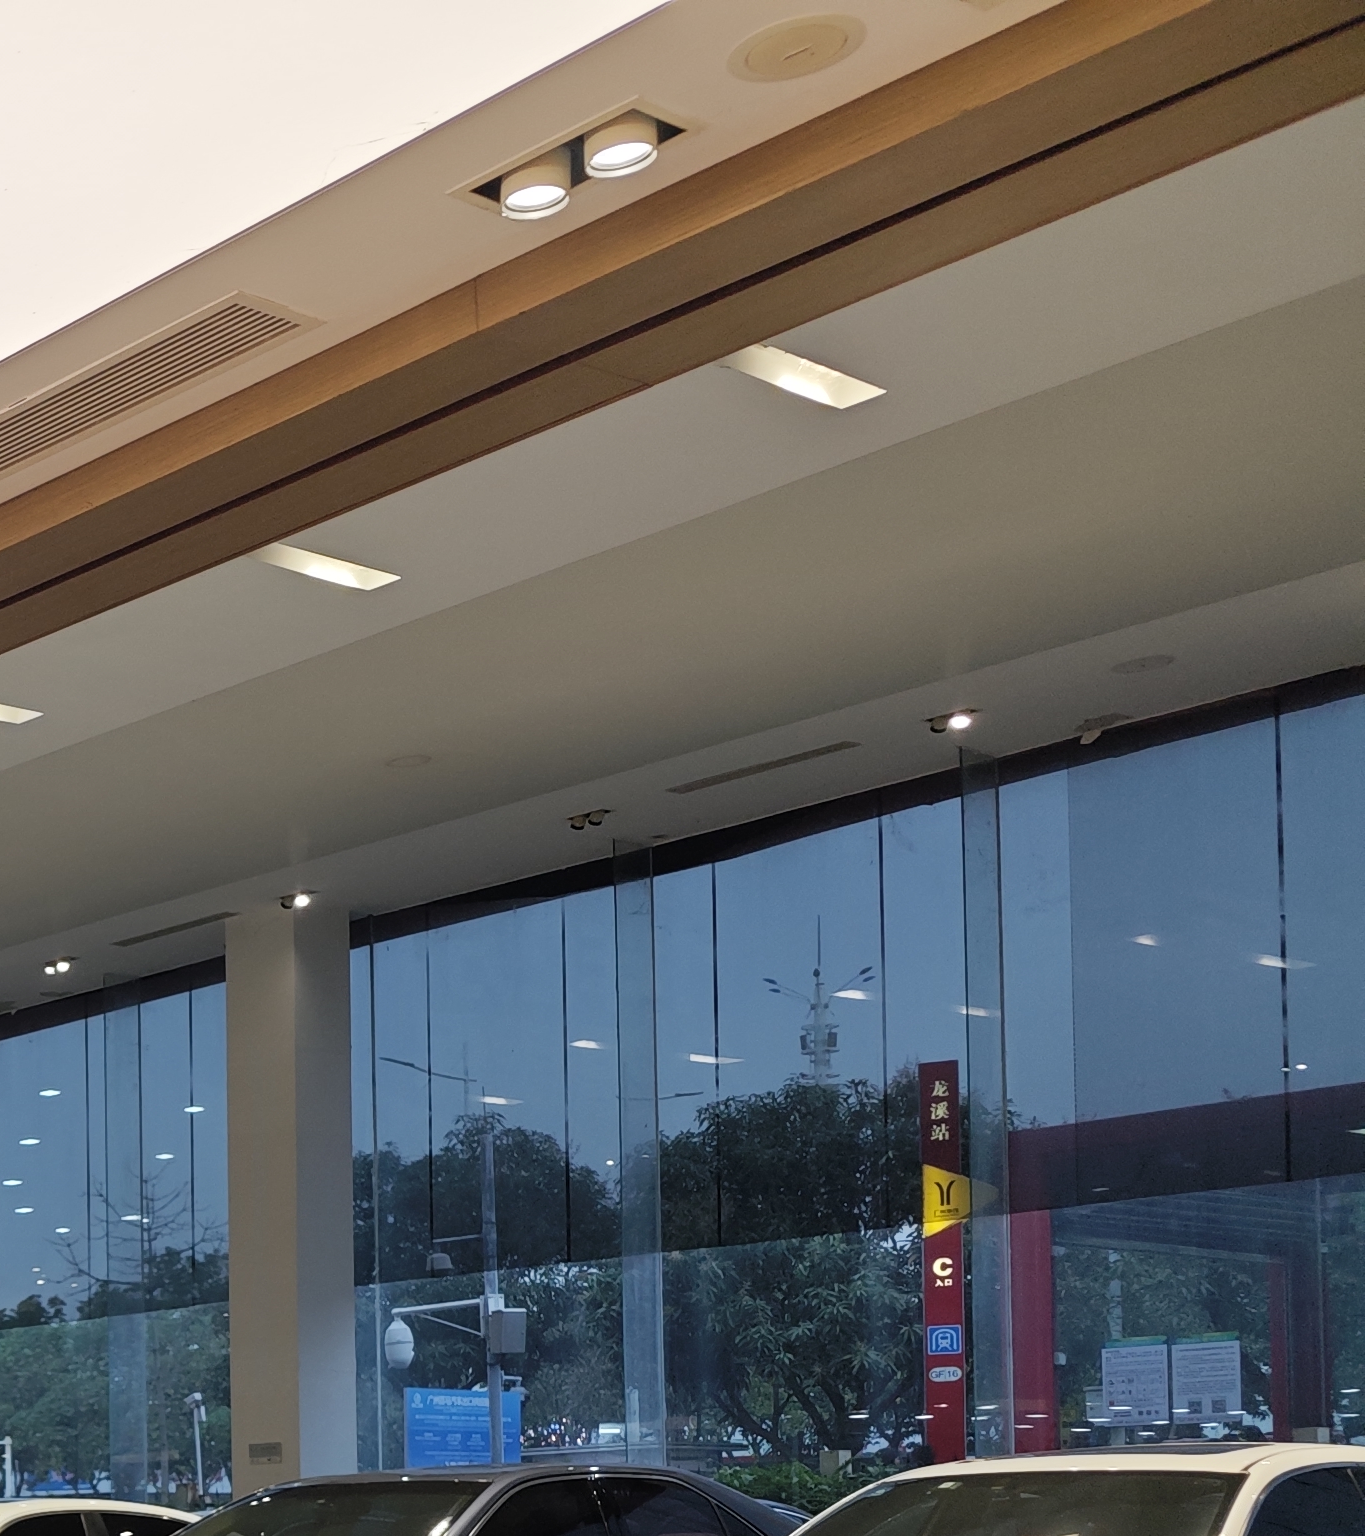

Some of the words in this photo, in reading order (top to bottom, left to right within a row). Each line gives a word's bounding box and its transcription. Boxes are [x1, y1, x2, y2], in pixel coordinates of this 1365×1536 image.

[929, 1080, 950, 1141] 龙溪站
[932, 1257, 954, 1278] C
[934, 1279, 954, 1288] 入口
